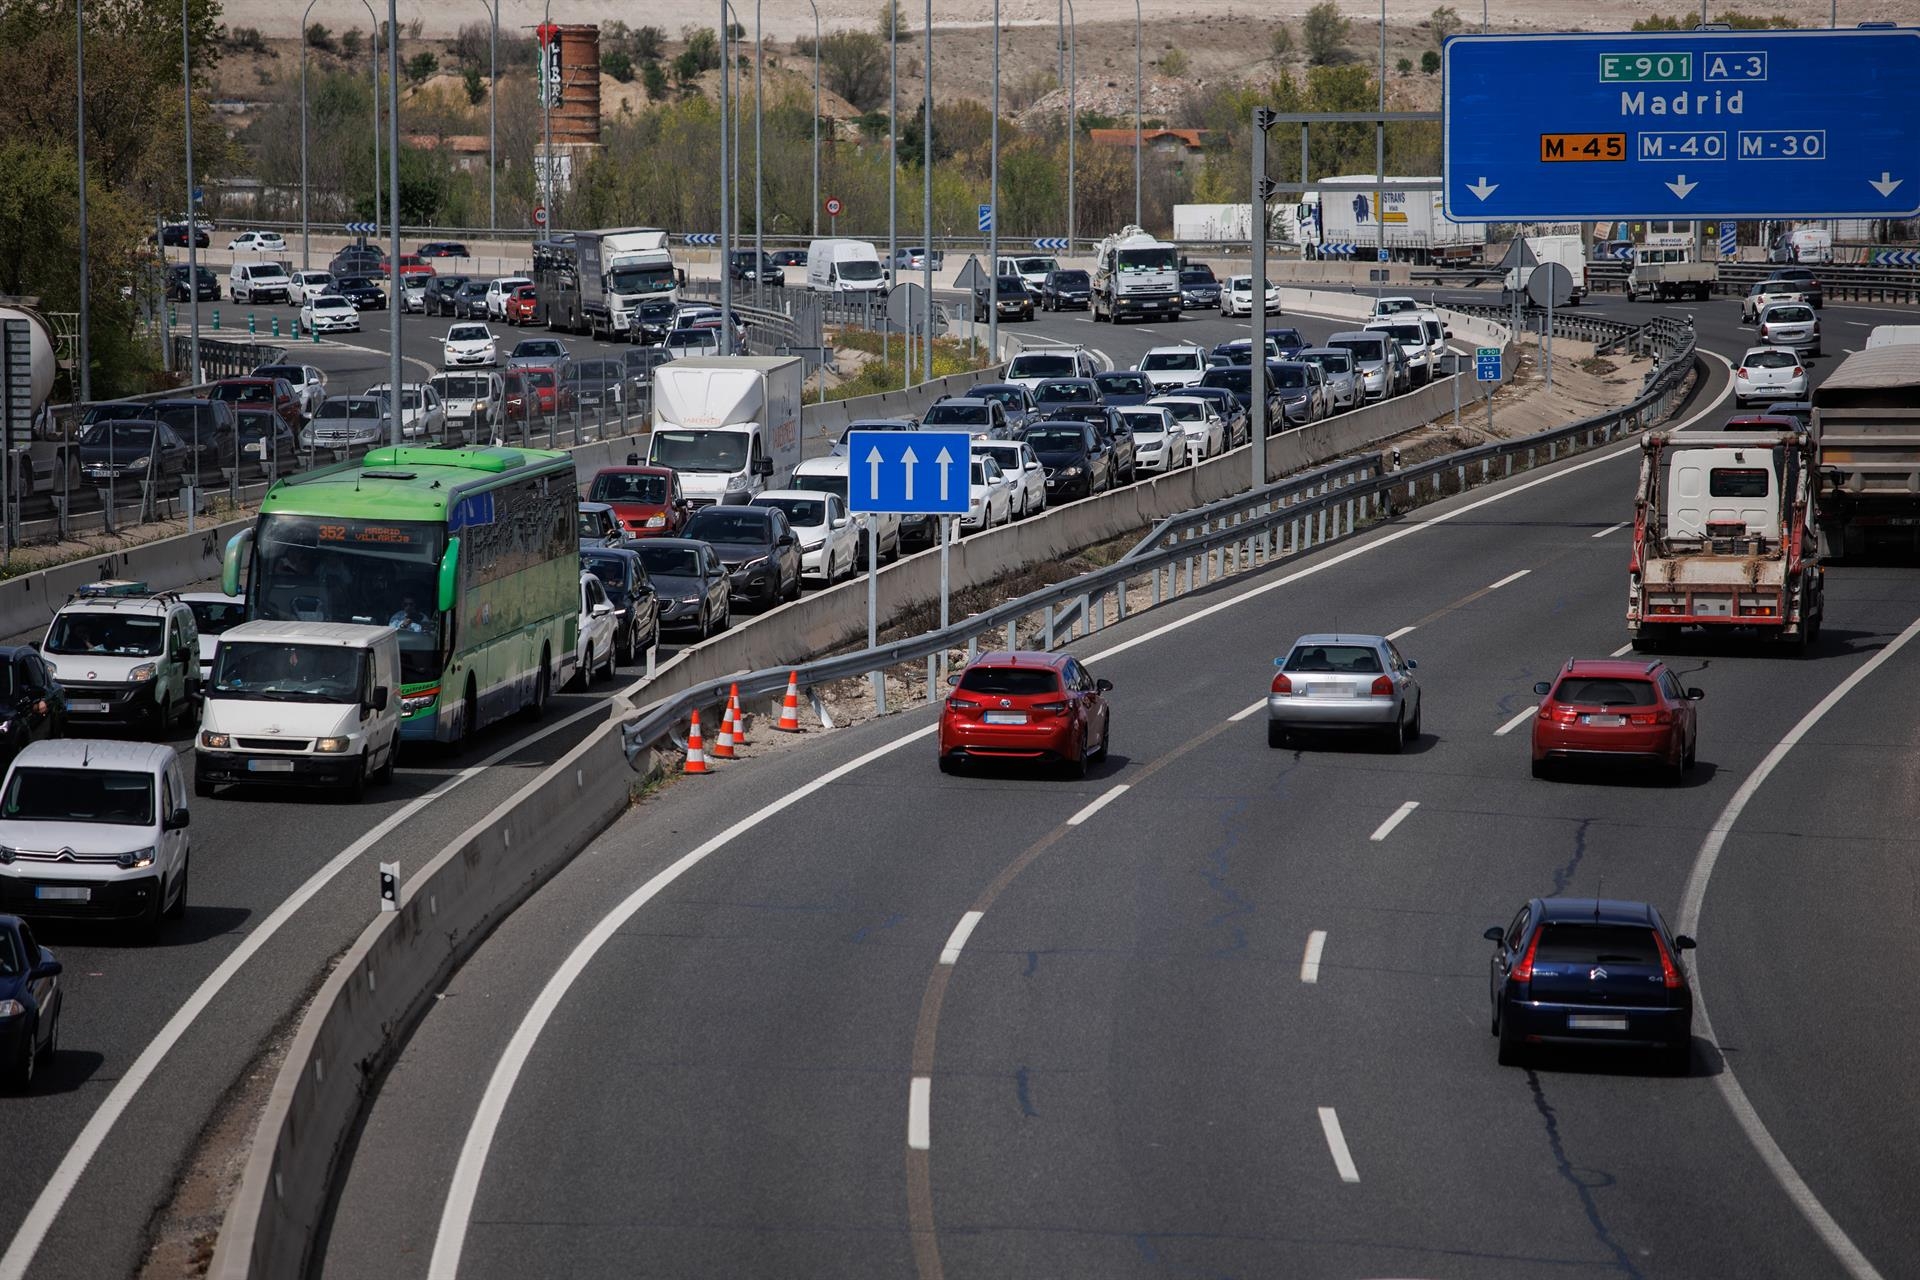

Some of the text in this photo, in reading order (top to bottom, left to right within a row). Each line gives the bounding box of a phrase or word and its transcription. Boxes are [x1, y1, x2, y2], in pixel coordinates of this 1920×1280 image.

[1603, 56, 1762, 78] E-901 A-3
[1621, 90, 1744, 116] Madrid
[1545, 135, 1820, 158] M-45 M-40 M-30
[319, 525, 401, 541] 352 MADRID
